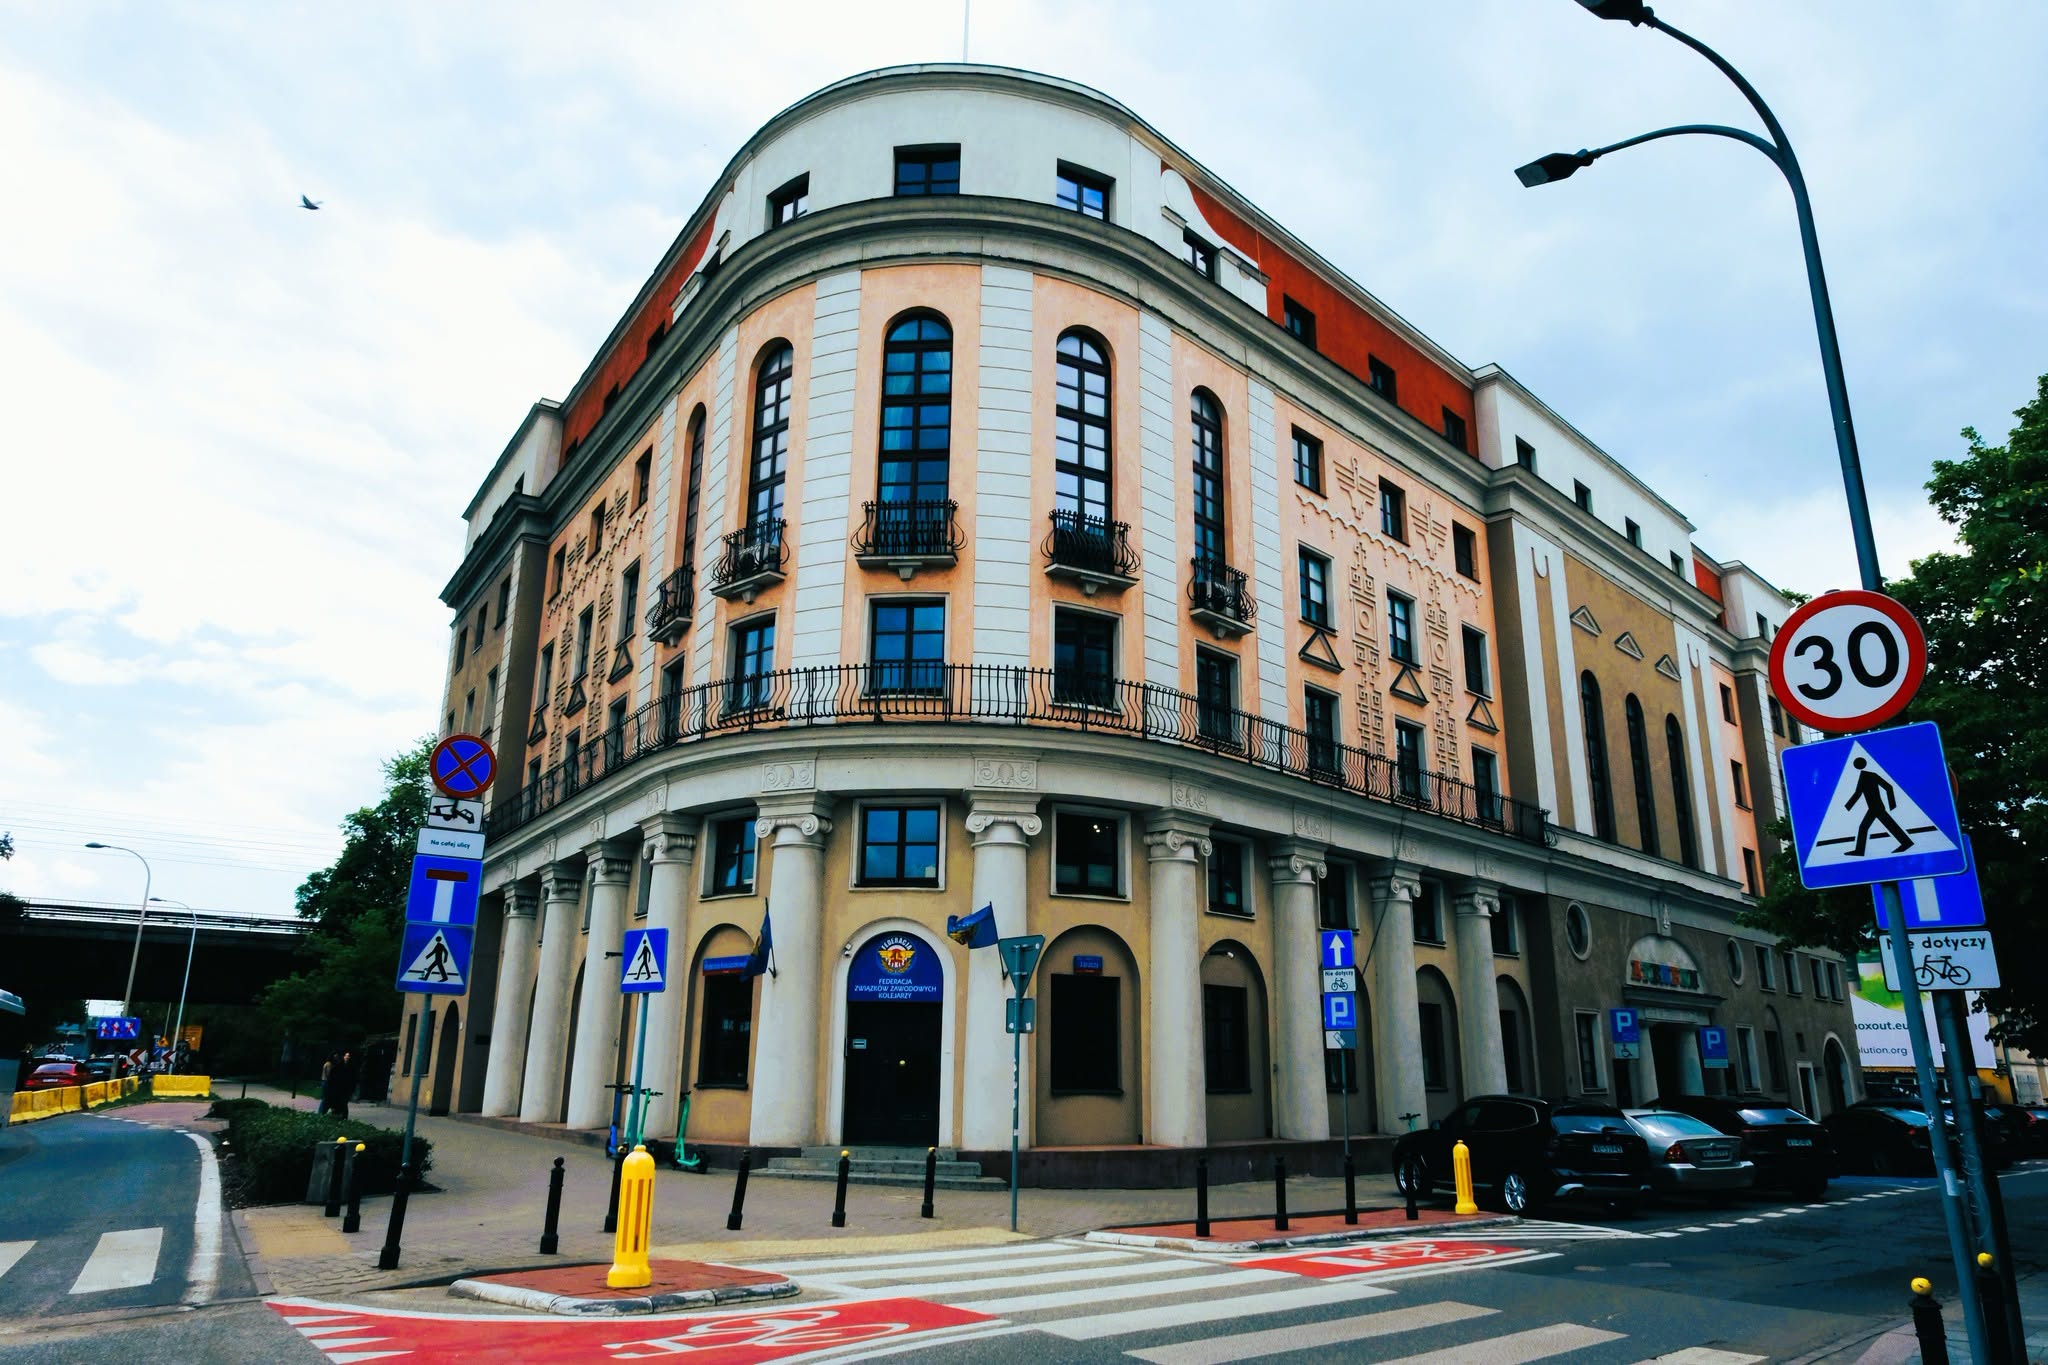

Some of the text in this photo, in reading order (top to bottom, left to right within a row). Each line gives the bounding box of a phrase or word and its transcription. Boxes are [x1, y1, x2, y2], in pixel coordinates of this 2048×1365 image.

[1794, 621, 1899, 700] 30
[1922, 936, 1986, 951] dotyczy
[1331, 997, 1348, 1026] P
[1616, 1012, 1632, 1032] P
[1854, 1022, 1909, 1030] oxout.eu
[1706, 1031, 1721, 1049] P
[1858, 1046, 1908, 1057] lution.org
